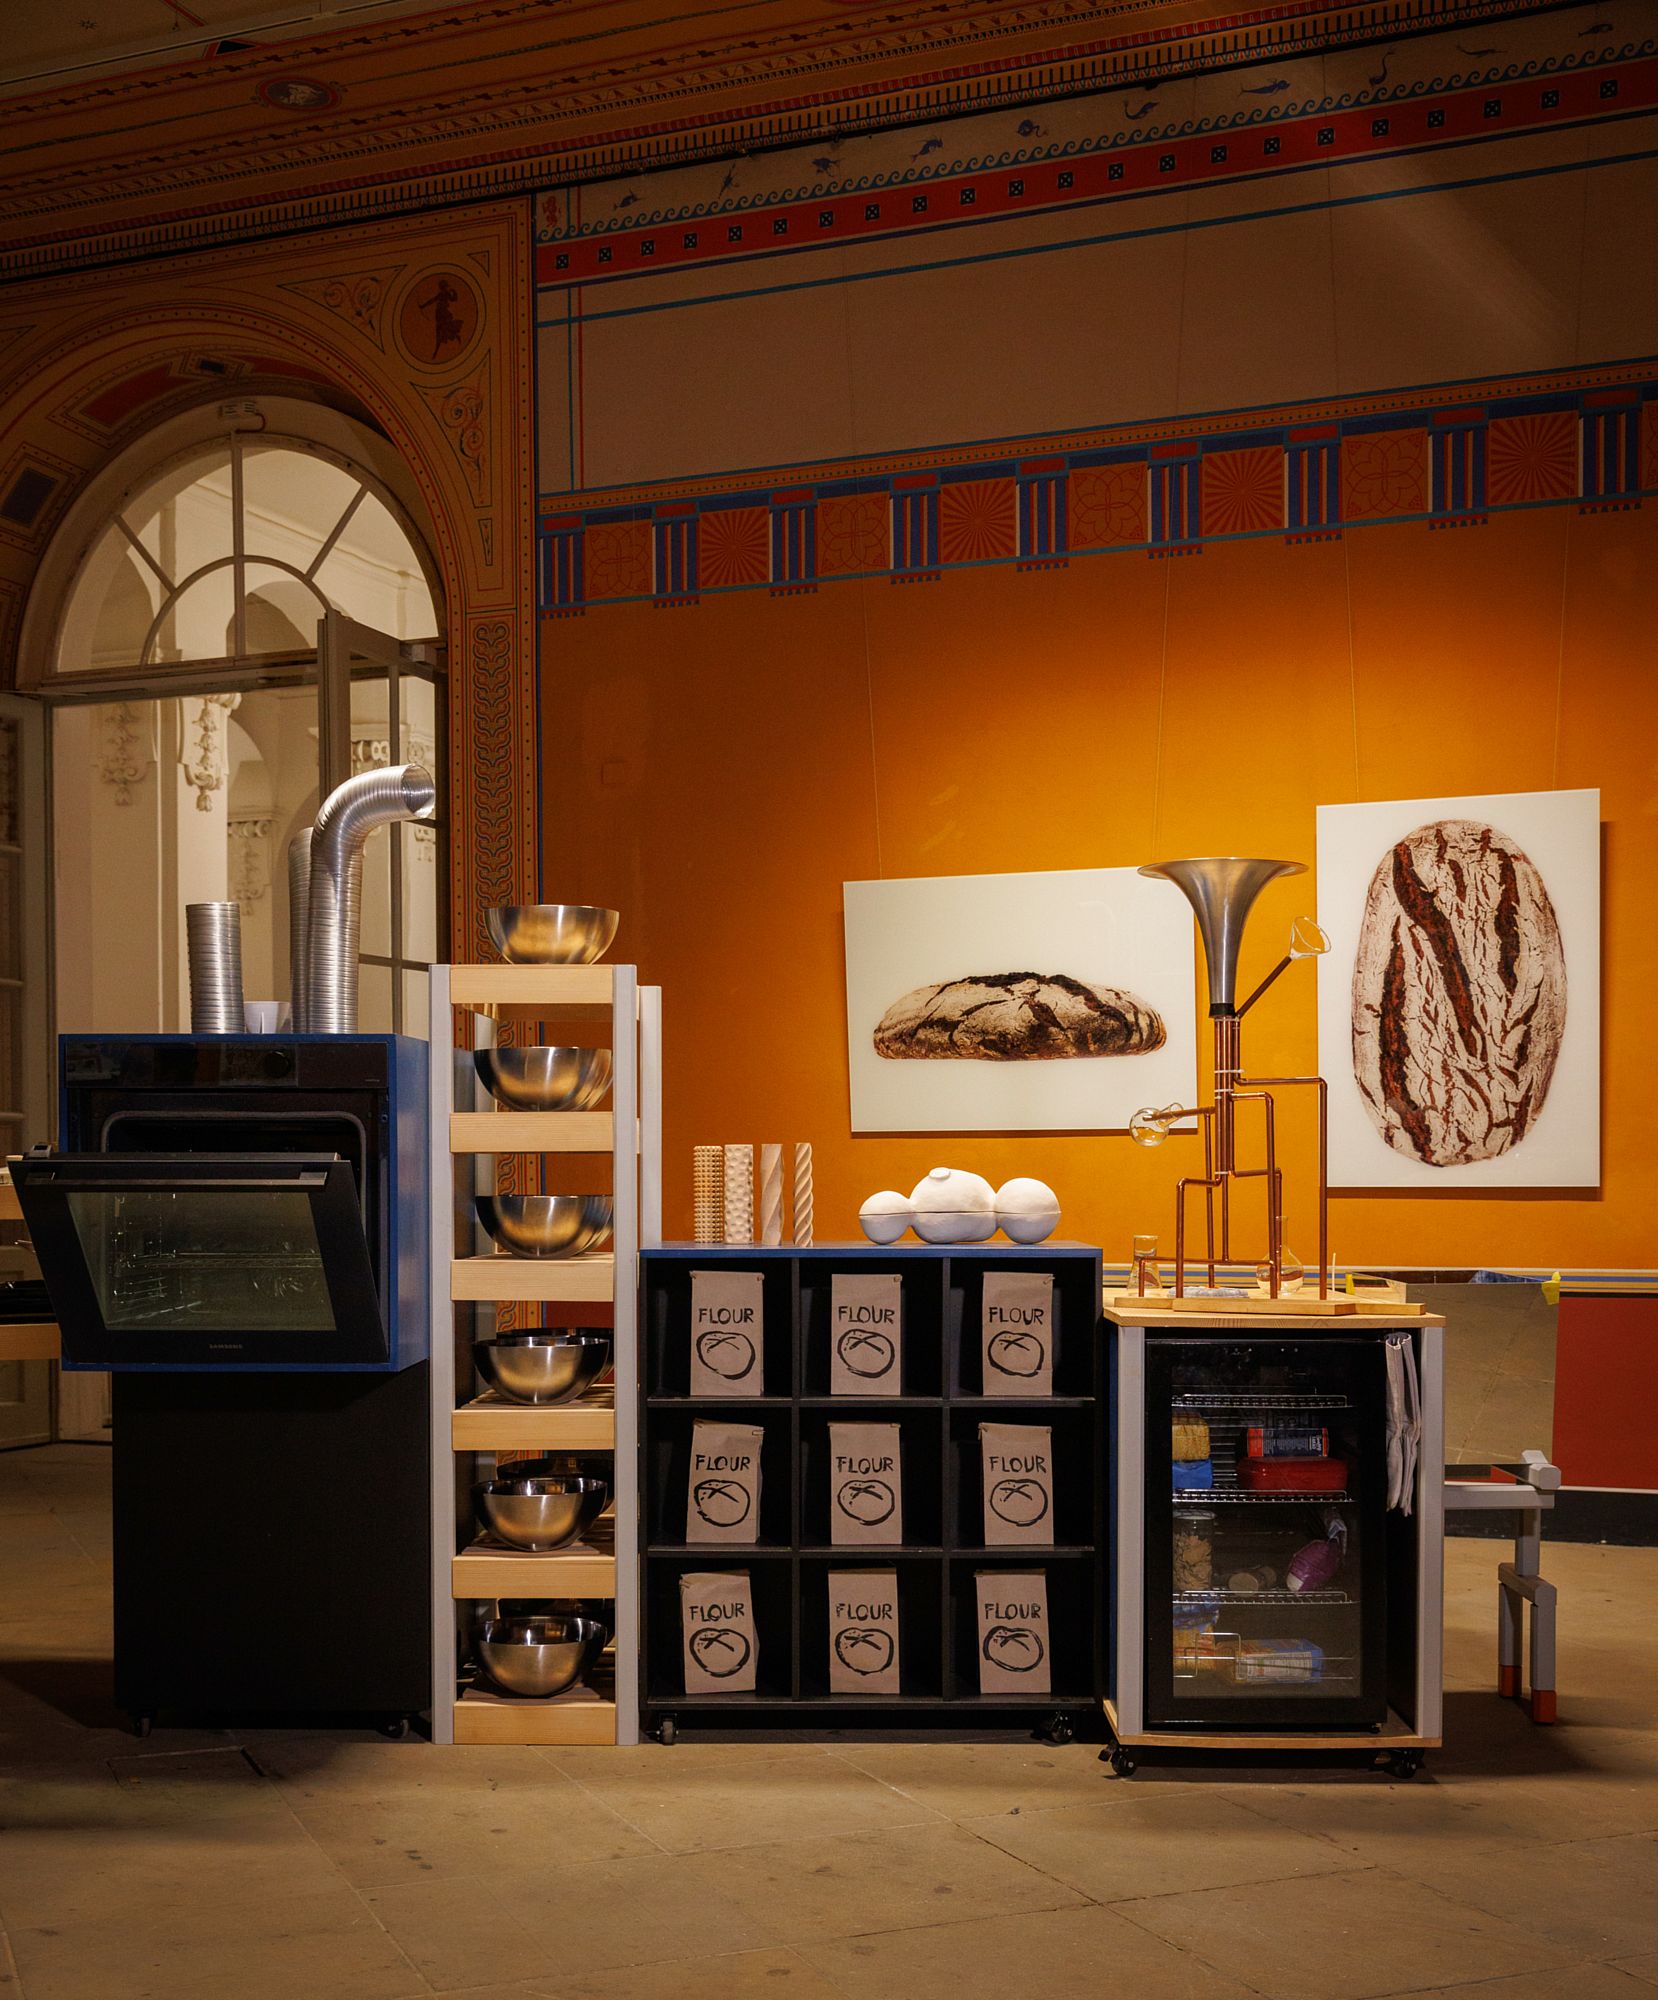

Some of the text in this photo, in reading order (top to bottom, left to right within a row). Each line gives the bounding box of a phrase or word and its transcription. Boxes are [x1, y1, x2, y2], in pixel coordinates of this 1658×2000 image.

[699, 1308, 753, 1324] FLOUR
[839, 1305, 895, 1324] FLOUR
[989, 1307, 1044, 1325] FLOUR
[696, 1454, 750, 1471] FLOUR
[836, 1457, 893, 1475] FLOUR
[989, 1455, 1046, 1473] FLOUR
[689, 1603, 744, 1622] FLOUR
[836, 1603, 892, 1621] FLOUR
[985, 1603, 1041, 1620] FLOUR
